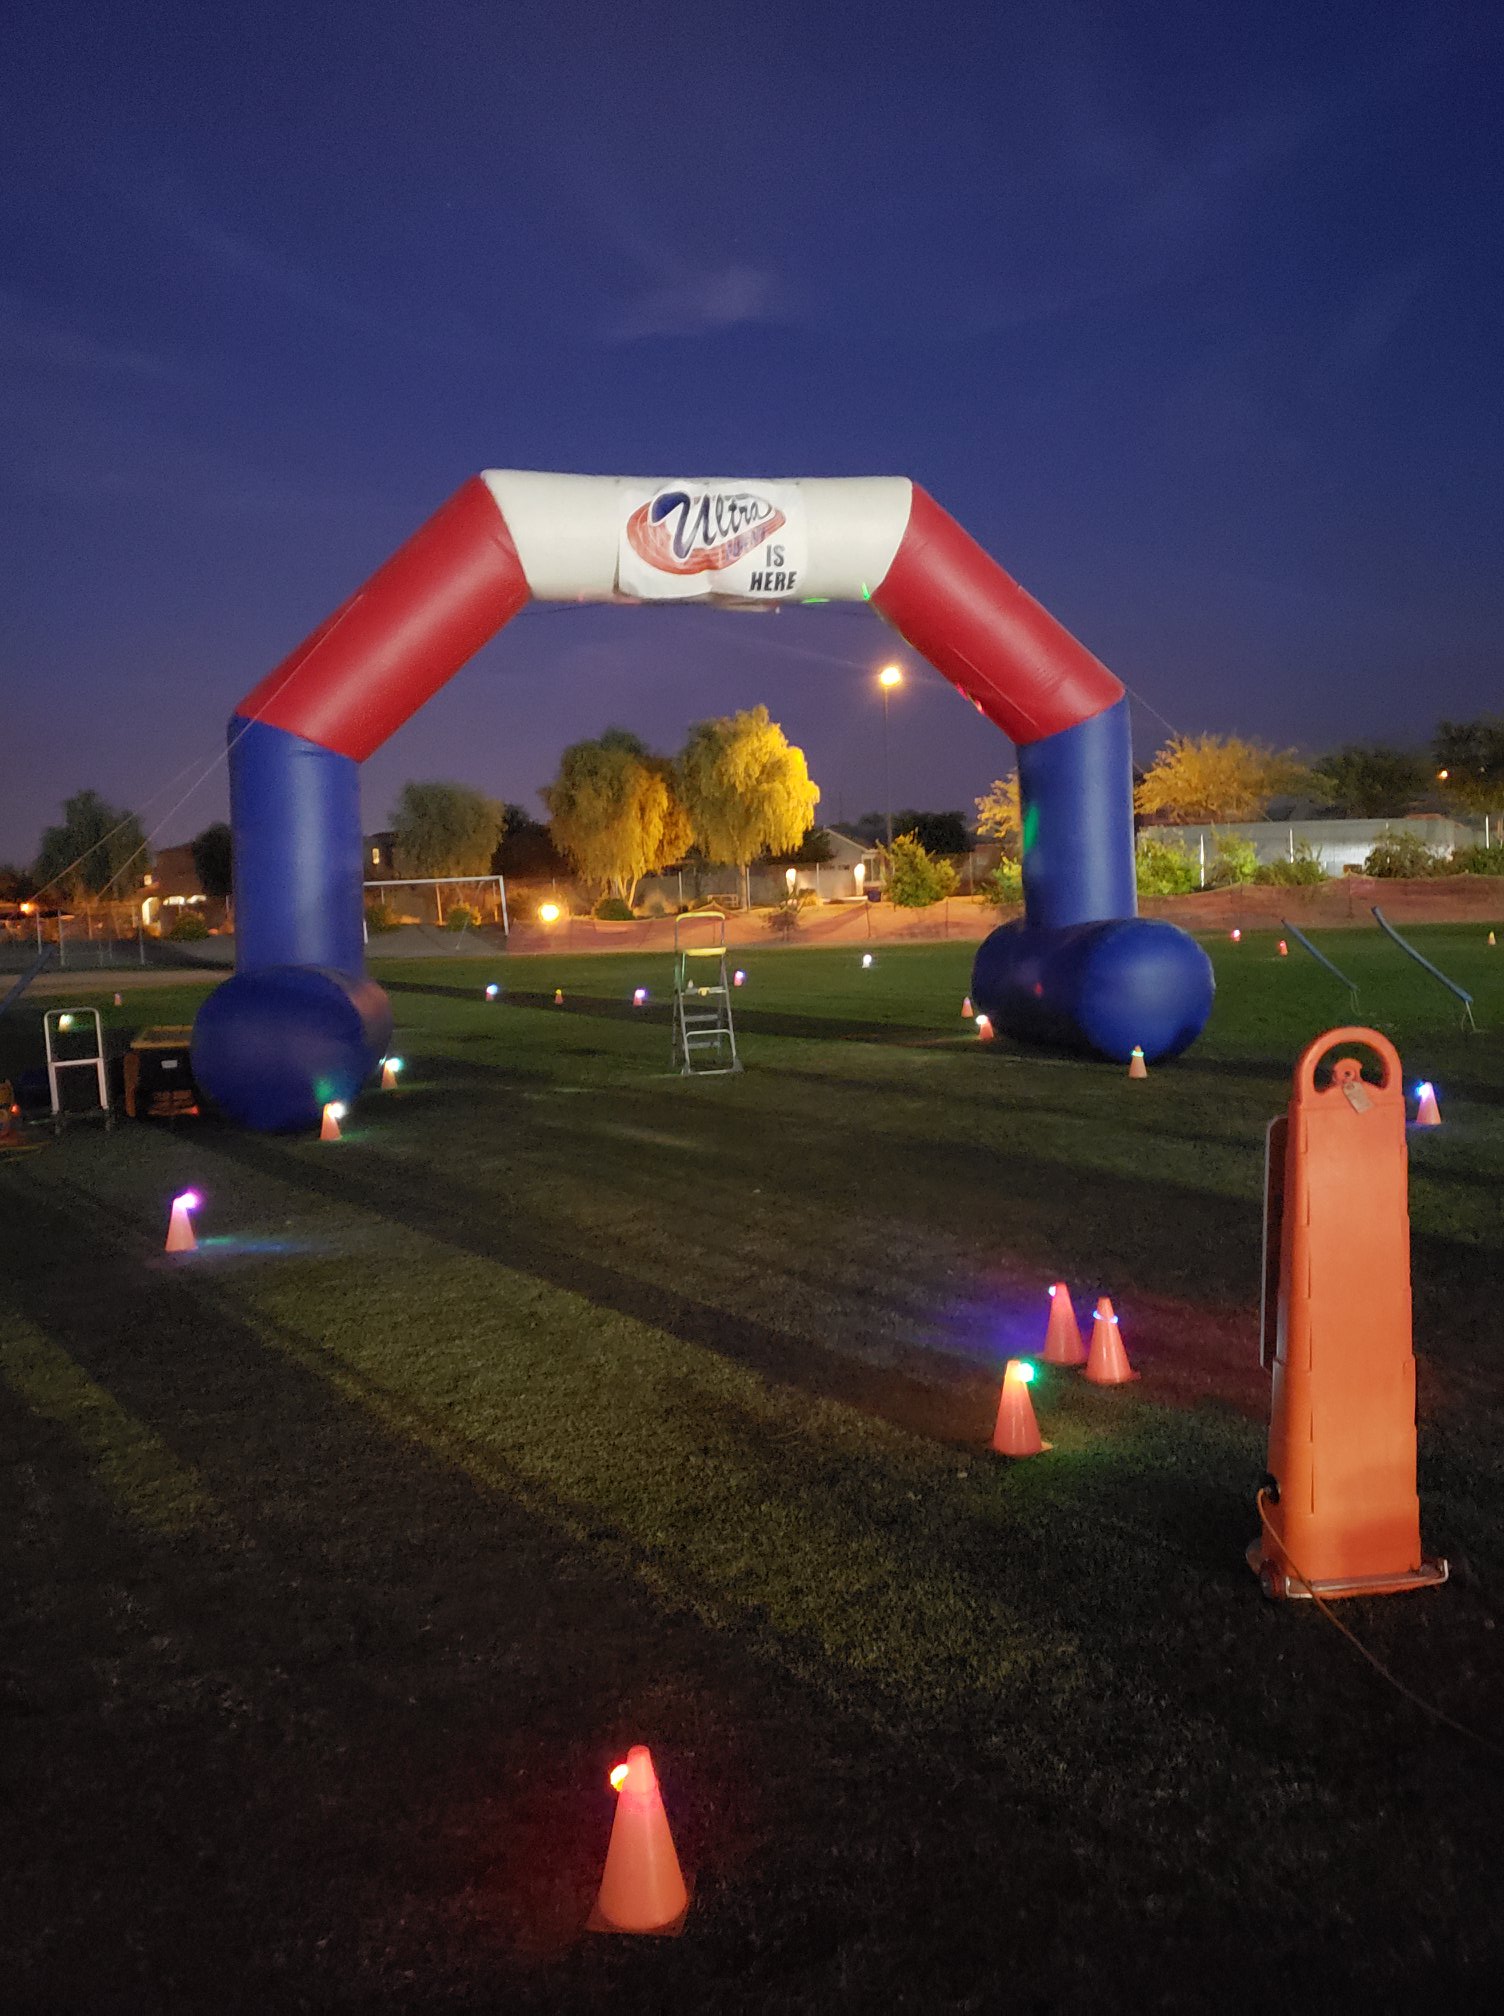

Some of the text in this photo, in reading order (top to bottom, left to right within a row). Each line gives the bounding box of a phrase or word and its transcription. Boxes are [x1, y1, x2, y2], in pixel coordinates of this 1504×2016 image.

[652, 492, 773, 558] Ultra
[766, 544, 785, 567] IS
[750, 571, 798, 592] HERE
